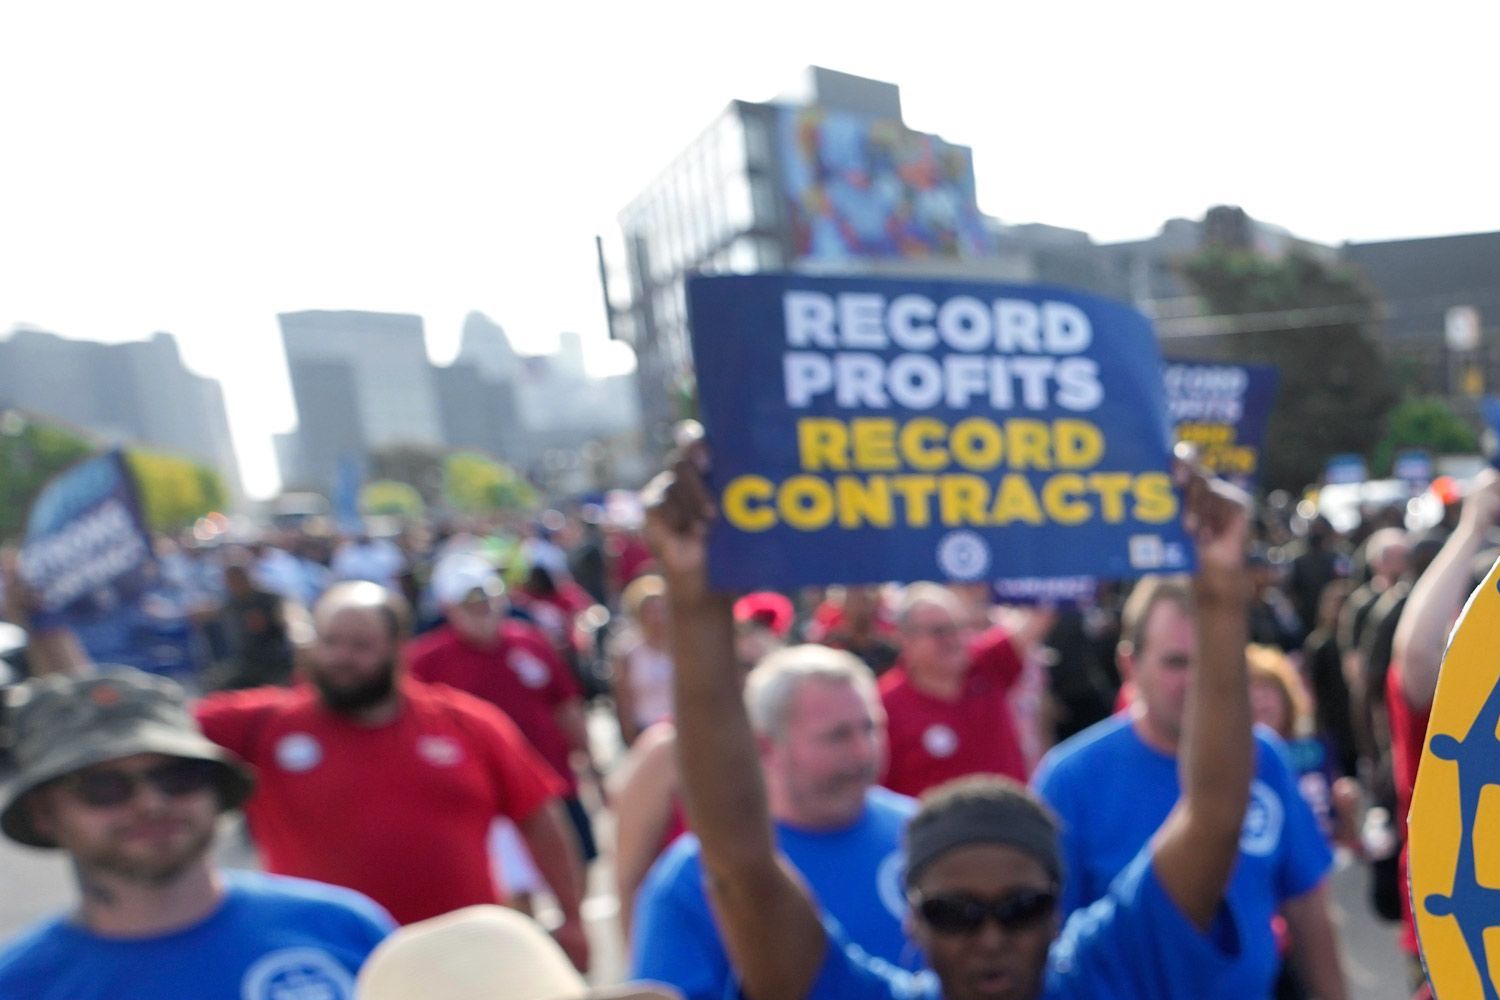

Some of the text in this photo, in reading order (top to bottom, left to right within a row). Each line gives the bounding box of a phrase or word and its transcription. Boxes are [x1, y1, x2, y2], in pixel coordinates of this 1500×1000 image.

[783, 291, 1093, 354] RECORD
[783, 351, 1105, 411] PROFITS
[797, 416, 1106, 471] RECORD
[722, 471, 1179, 531] CONTRACTS
